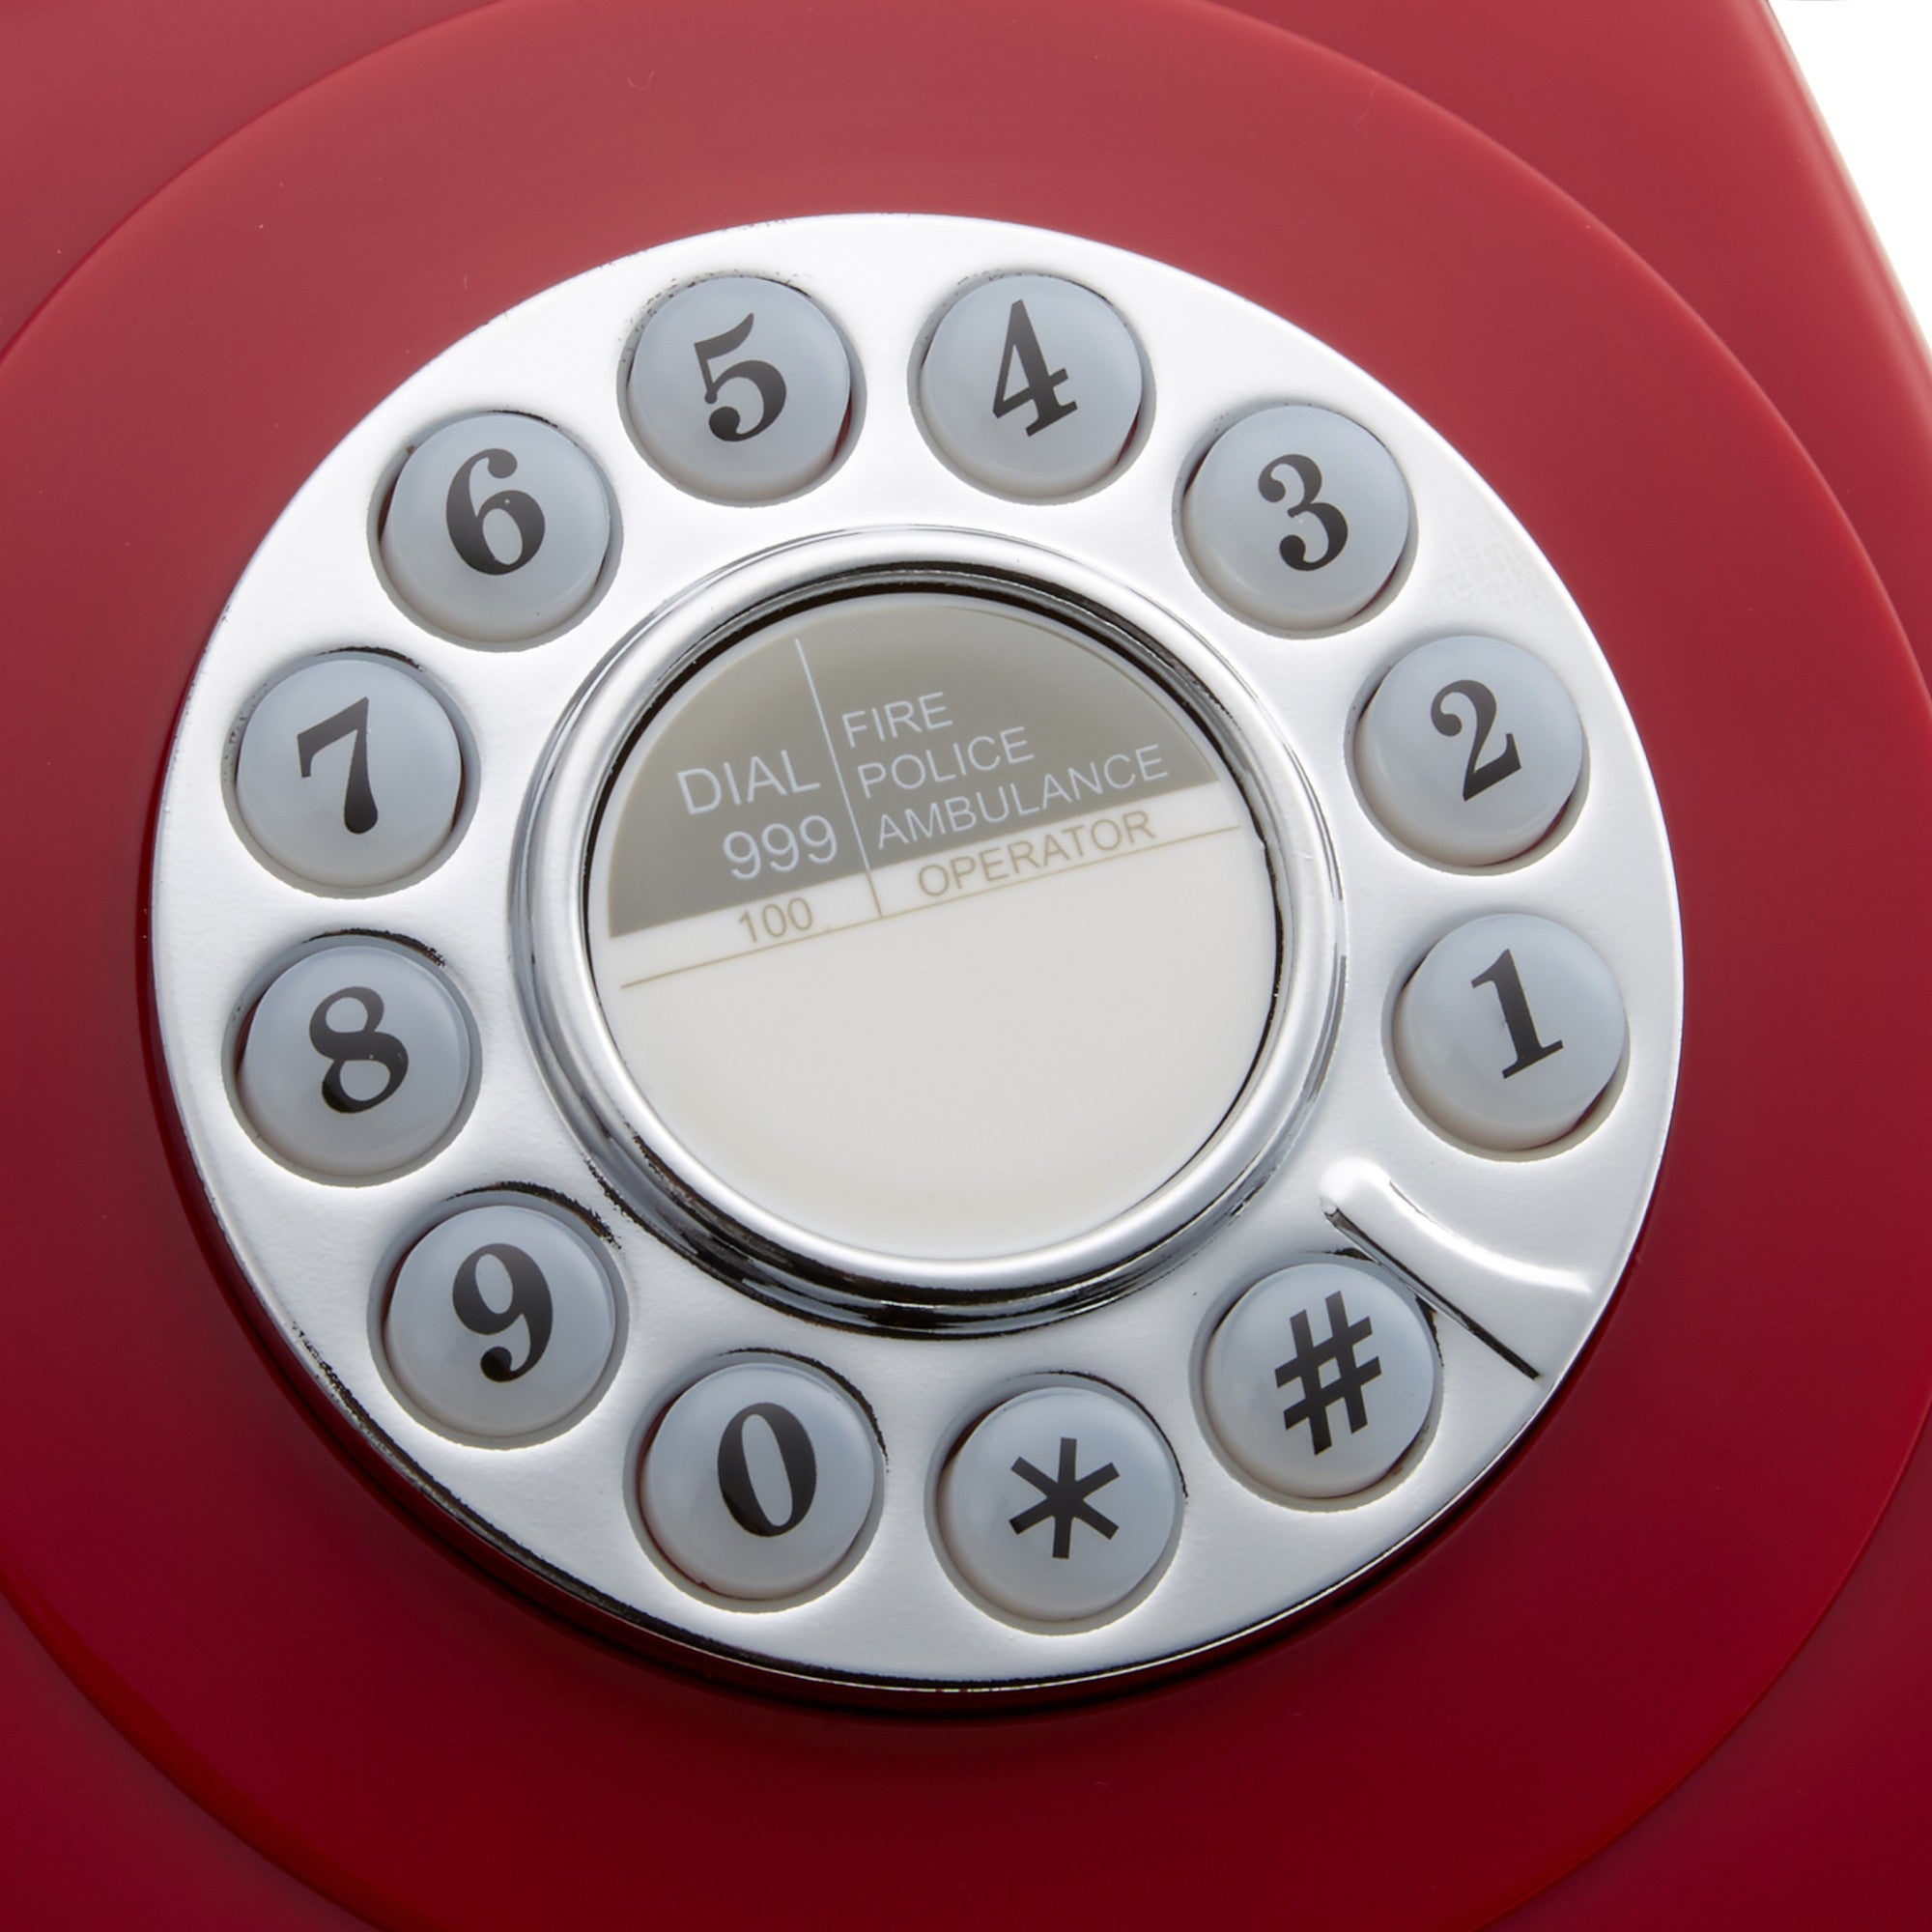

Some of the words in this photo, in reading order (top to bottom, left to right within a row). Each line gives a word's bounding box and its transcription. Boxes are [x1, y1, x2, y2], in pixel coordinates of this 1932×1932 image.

[695, 314, 786, 441] 5
[993, 300, 1077, 437] 4
[446, 449, 545, 576] 6
[1259, 455, 1348, 571] 3
[298, 697, 378, 835] 7
[840, 692, 952, 748] FIRE
[856, 725, 1035, 799] POLICE
[1432, 681, 1521, 802] 2
[676, 750, 821, 816] DIAL
[876, 743, 1169, 850] AMBULANCE
[721, 814, 838, 881] 999
[918, 810, 1156, 897] OPERATOR
[737, 897, 813, 944] 100
[309, 987, 409, 1114] 8
[1472, 950, 1563, 1079] 1
[452, 1244, 554, 1383] 9
[1274, 1292, 1381, 1456] #
[717, 1403, 817, 1538] 0
